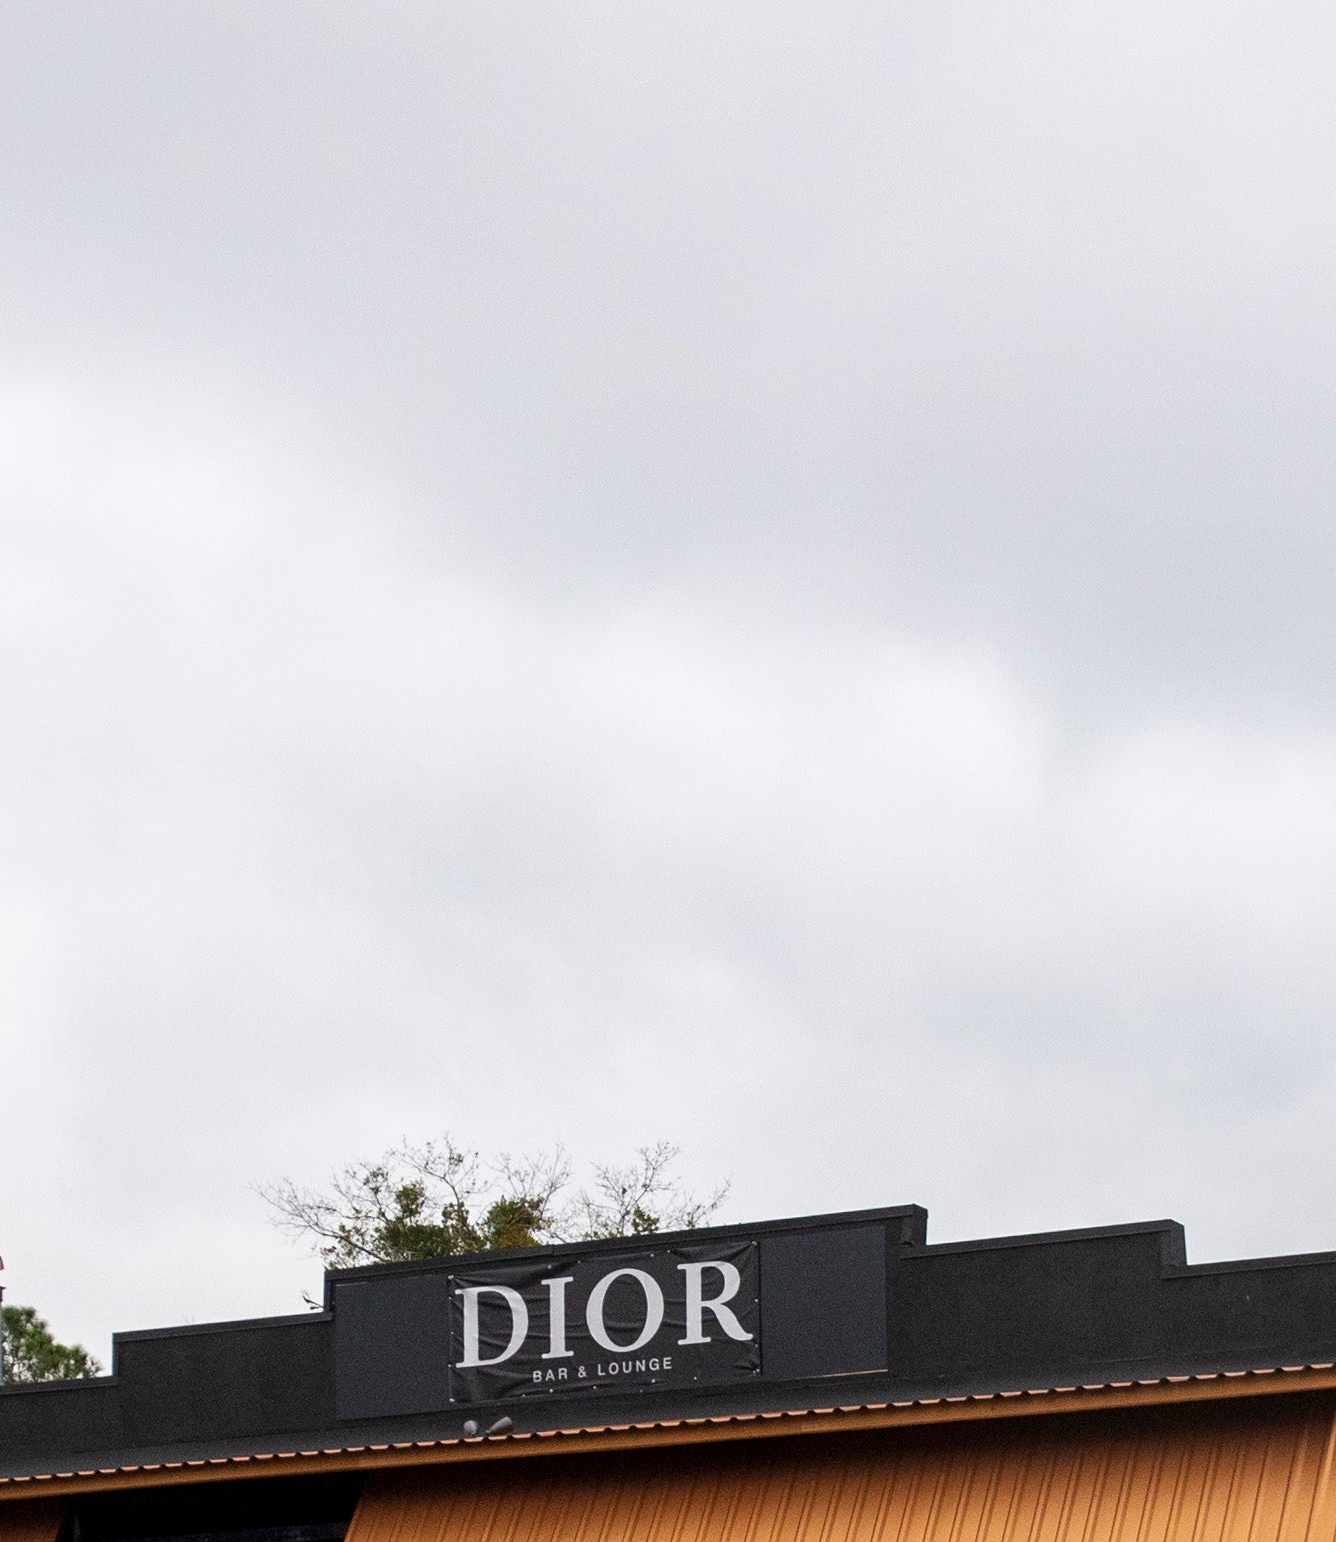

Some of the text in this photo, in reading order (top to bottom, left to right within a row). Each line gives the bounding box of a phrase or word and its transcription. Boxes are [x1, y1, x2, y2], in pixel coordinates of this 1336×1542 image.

[454, 1261, 753, 1368] DIOR
[532, 1357, 672, 1383] BAR & LOUNGE
